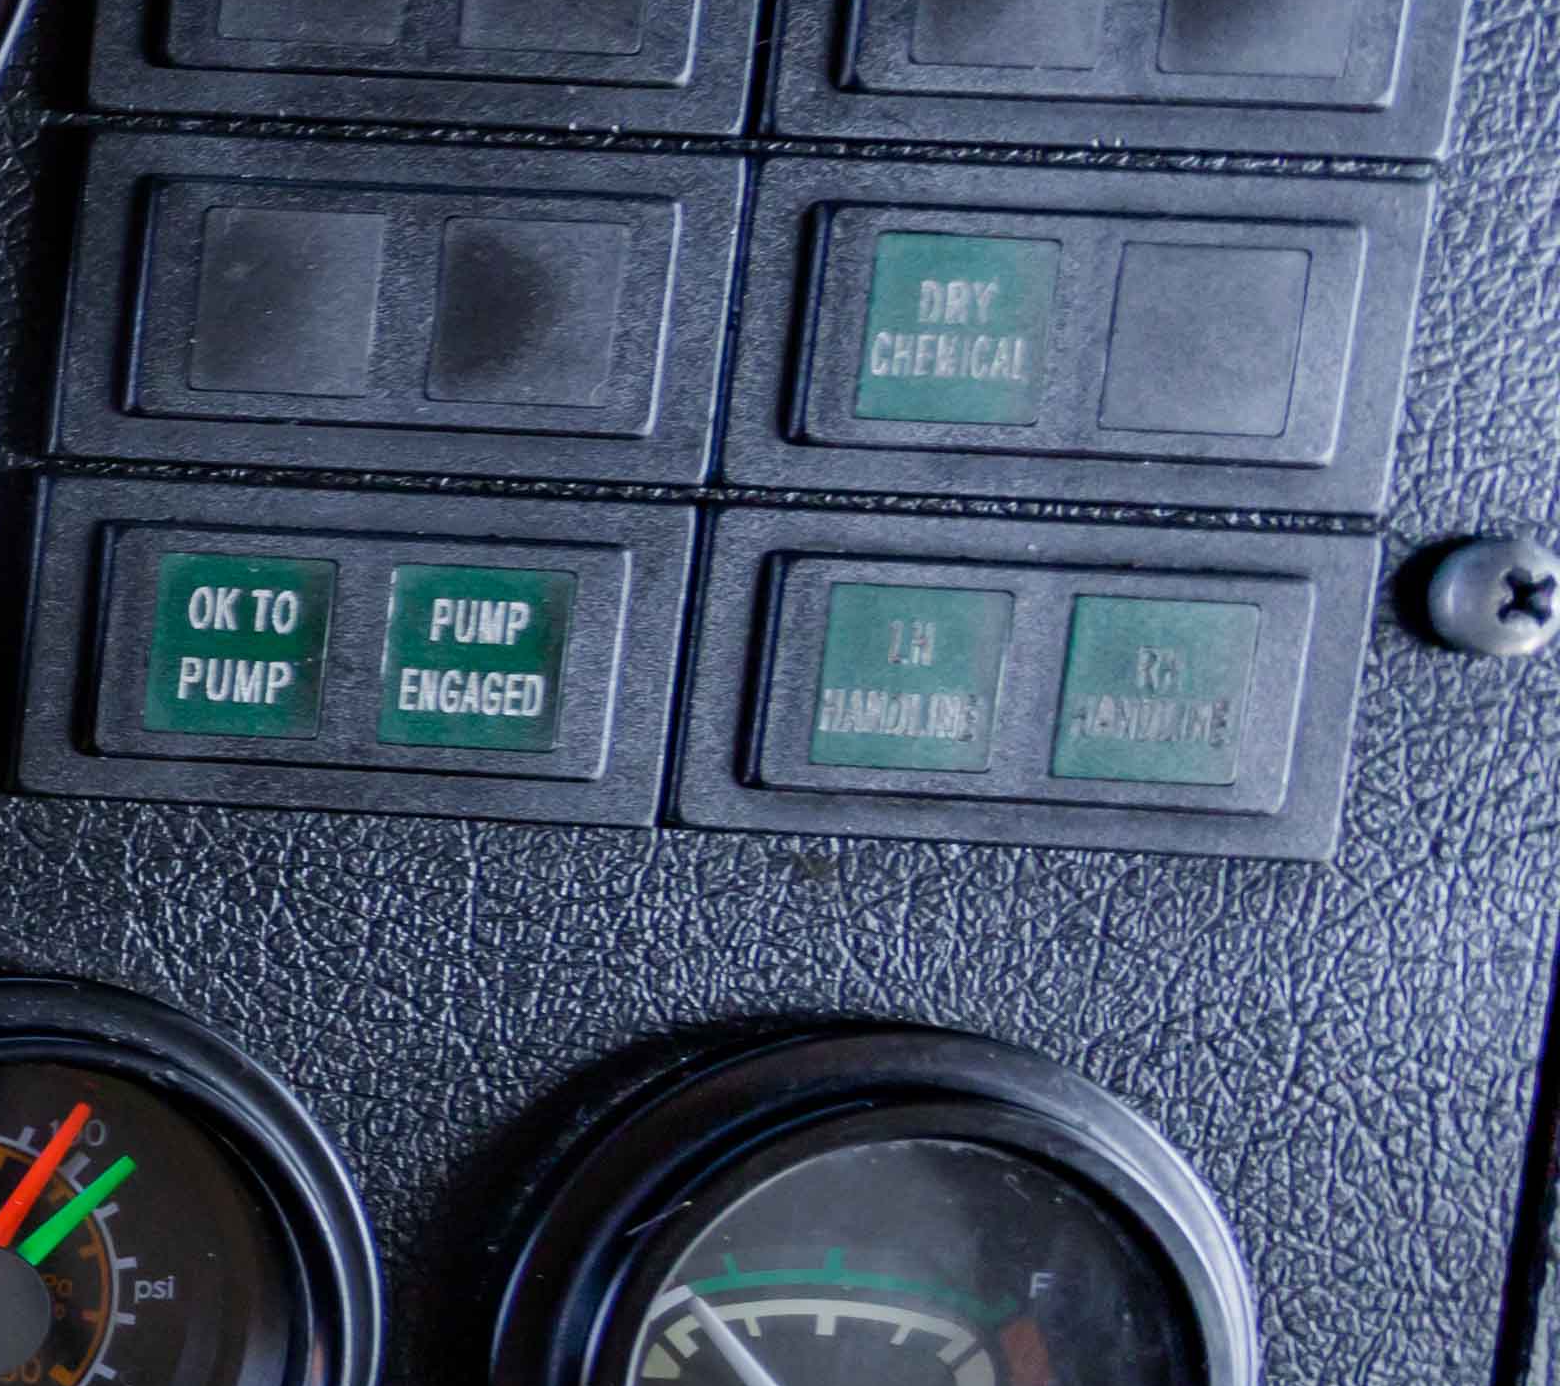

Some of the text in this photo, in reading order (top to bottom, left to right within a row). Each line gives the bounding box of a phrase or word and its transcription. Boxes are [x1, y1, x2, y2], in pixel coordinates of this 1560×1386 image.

[919, 277, 1001, 325] DRY
[871, 330, 1029, 381] CHEMICAL
[187, 585, 301, 636] OK TO
[428, 597, 532, 647] PUMP
[176, 656, 294, 705] PUMP
[397, 667, 546, 718] ENGAGED
[133, 1274, 176, 1304] psi
[1028, 1269, 1057, 1301] F
